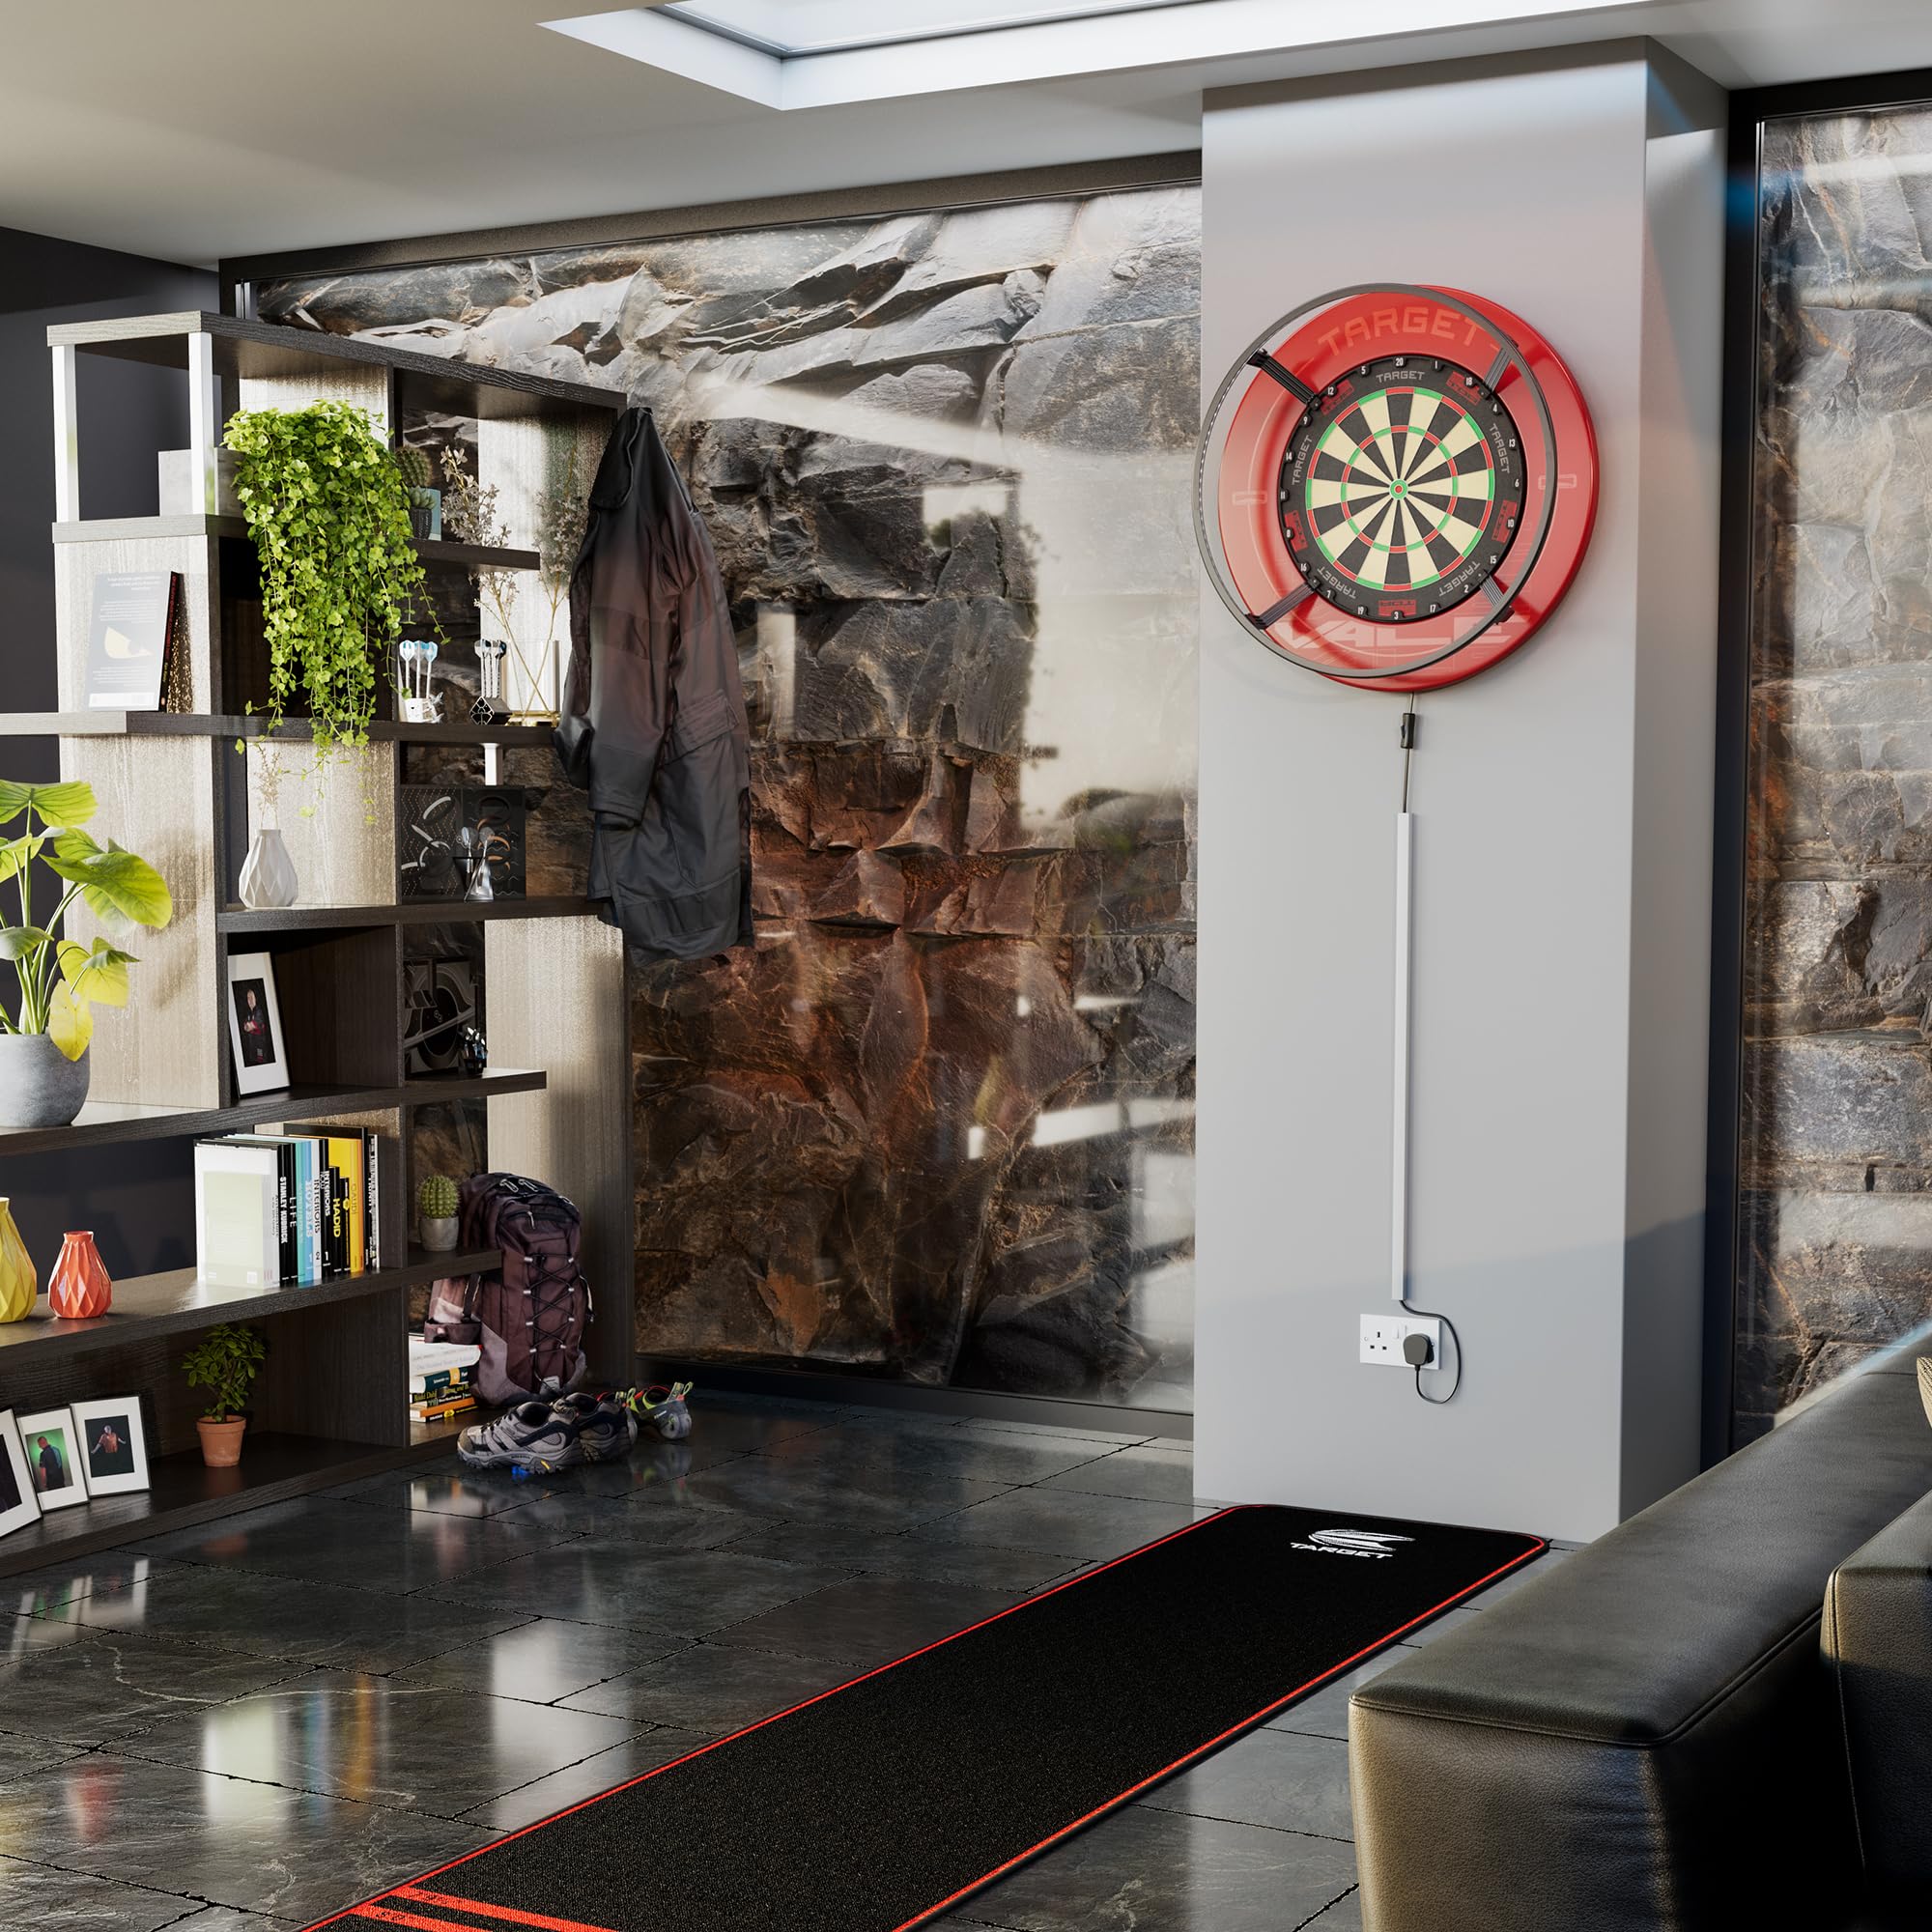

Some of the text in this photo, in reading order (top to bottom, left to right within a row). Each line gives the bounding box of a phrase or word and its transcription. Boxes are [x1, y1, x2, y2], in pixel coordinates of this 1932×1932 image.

[1318, 306, 1488, 356] TARGET
[1395, 357, 1404, 366] 20
[1435, 360, 1438, 369] 1
[1361, 366, 1366, 375] 5
[1376, 370, 1425, 384] TARGET
[1465, 377, 1473, 385] 18
[1327, 386, 1334, 395] 12
[1492, 404, 1497, 412] 4
[1303, 416, 1308, 425] 9
[1509, 439, 1516, 447] 13
[1489, 423, 1510, 474] TARGET
[1286, 452, 1293, 461] 14
[1292, 435, 1313, 486] TARGET
[1515, 478, 1520, 487] 6
[1507, 519, 1514, 527] 10
[1490, 555, 1497, 564] 15
[1300, 563, 1307, 572] 16
[1317, 566, 1357, 599] TARGET
[1438, 560, 1481, 597] TARGET
[1463, 584, 1469, 593] 2
[1357, 607, 1364, 615] 19
[1430, 605, 1436, 613] 17
[1394, 611, 1399, 620] 3
[332, 1198, 341, 1237] HADID
[325, 1251, 328, 1261] 1
